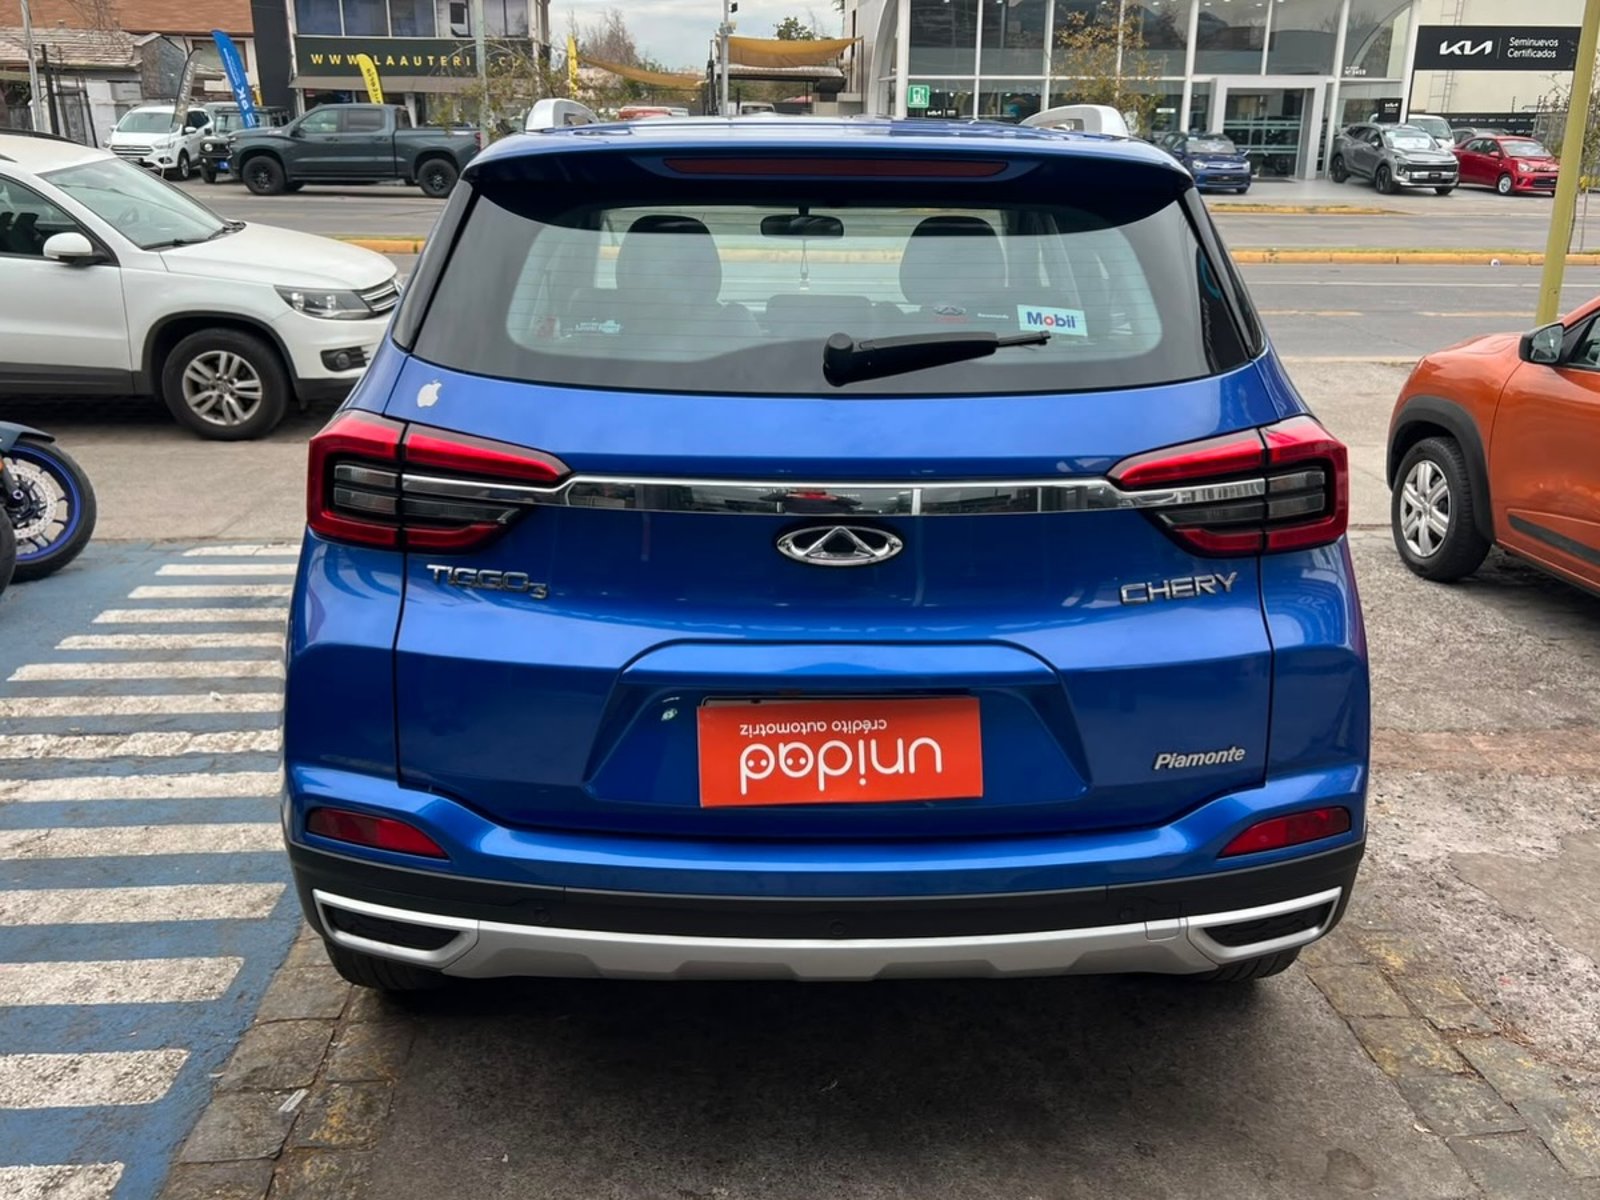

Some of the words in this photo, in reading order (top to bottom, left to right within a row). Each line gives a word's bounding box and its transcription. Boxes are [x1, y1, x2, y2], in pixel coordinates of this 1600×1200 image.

[1439, 40, 1493, 55] KIA
[1508, 36, 1559, 47] Seminuevos
[1507, 48, 1557, 58] Certificados
[1026, 311, 1076, 329] Mobil
[1120, 571, 1238, 605] CHERY
[739, 720, 828, 738] automotriz
[831, 718, 888, 735] crédito
[739, 737, 943, 796] unidad
[1153, 745, 1246, 771] Piamonte
